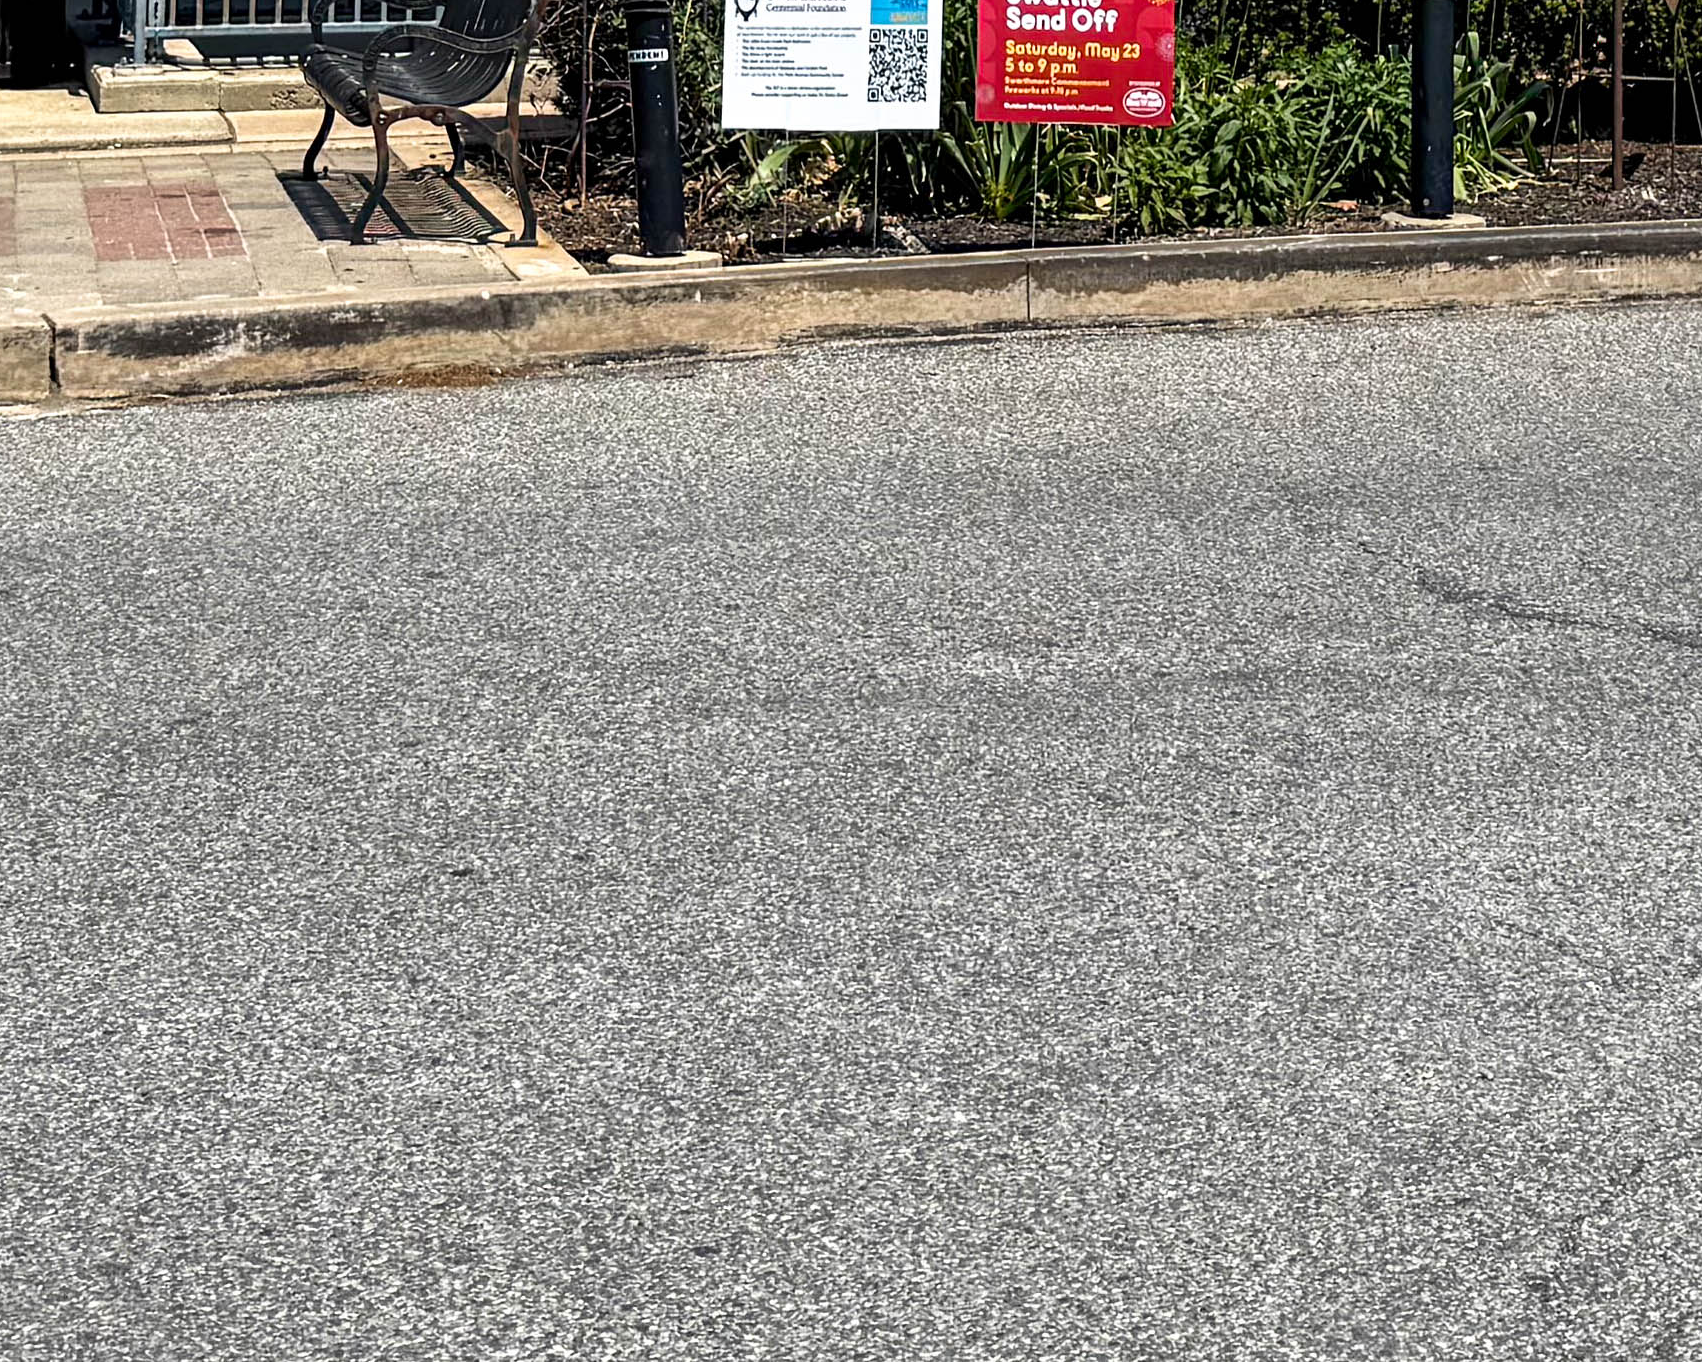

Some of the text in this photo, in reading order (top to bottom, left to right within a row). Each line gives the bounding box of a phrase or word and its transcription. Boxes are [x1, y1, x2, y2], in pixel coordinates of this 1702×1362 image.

[1006, 6, 1119, 33] Send Off
[1006, 40, 1141, 62] Saturday, May 23
[1005, 58, 1015, 73] 5
[1019, 59, 1035, 73] to
[1037, 59, 1048, 74] 9
